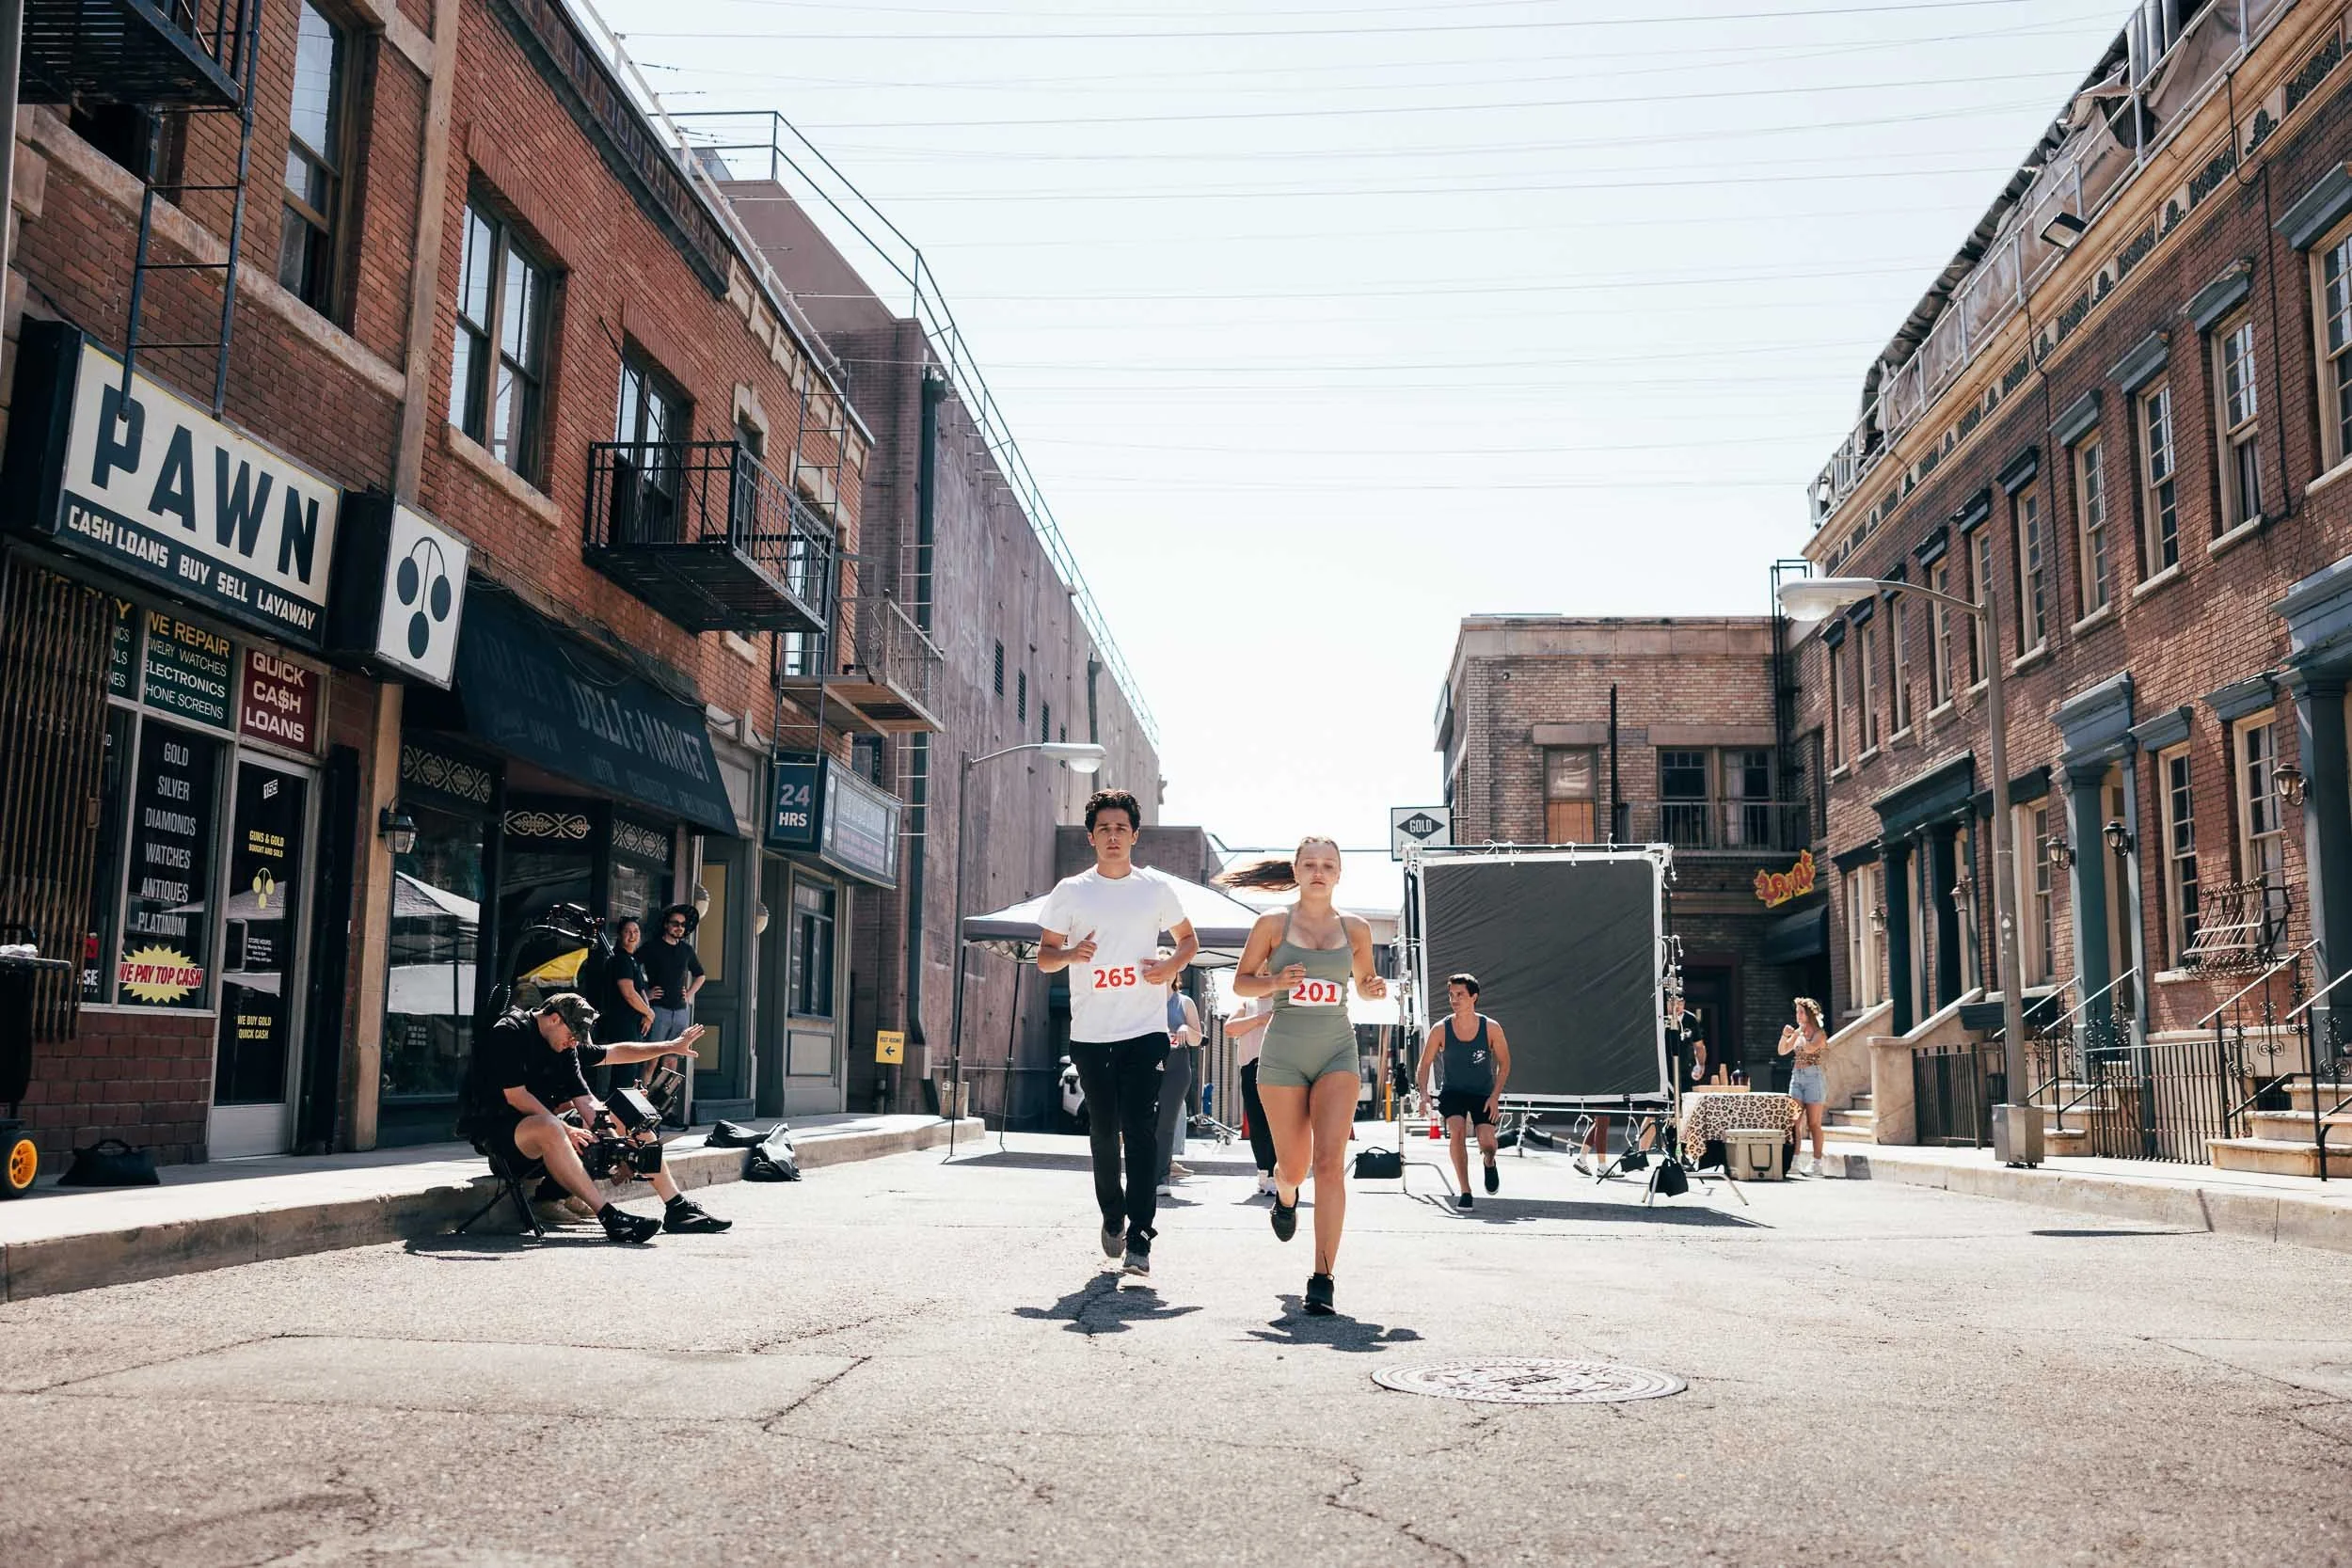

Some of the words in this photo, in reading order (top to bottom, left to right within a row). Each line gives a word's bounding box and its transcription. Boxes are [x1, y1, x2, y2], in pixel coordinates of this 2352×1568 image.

[91, 384, 319, 585] PAWN
[69, 505, 115, 545] CASH
[116, 525, 170, 569] LOANS
[179, 554, 212, 585] BUY
[216, 570, 249, 603] SELL
[257, 588, 317, 631] LAYAWAY
[174, 620, 230, 658] REPAIR
[179, 648, 228, 677] WATCHES
[252, 651, 306, 688] QUICK
[145, 682, 177, 705] HONE
[177, 693, 225, 721] SCREENS
[246, 706, 306, 743] LOANS
[164, 741, 190, 768] GOLD
[636, 707, 710, 784] MARKET
[157, 774, 191, 802] SILVER
[779, 784, 812, 806] 24
[145, 807, 197, 837] DIAMONDS
[778, 812, 807, 829] HRS
[1409, 818, 1433, 833] GOLD
[249, 829, 264, 843] GUNS
[264, 832, 270, 844] &
[270, 834, 285, 847] GOLD
[145, 842, 192, 870] WATCHES
[140, 877, 189, 904] ANTIQUES
[137, 911, 188, 938] PLATINUM
[135, 964, 152, 984] PAY
[155, 965, 175, 985] TOP
[176, 967, 203, 987] CASH
[1092, 966, 1136, 990] 265
[1292, 981, 1339, 1004] 201
[237, 1015, 246, 1025] WE
[246, 1015, 258, 1026] BUY
[258, 1016, 272, 1026] GOLD
[238, 1028, 255, 1039] QUICK
[255, 1029, 269, 1039] CASH
